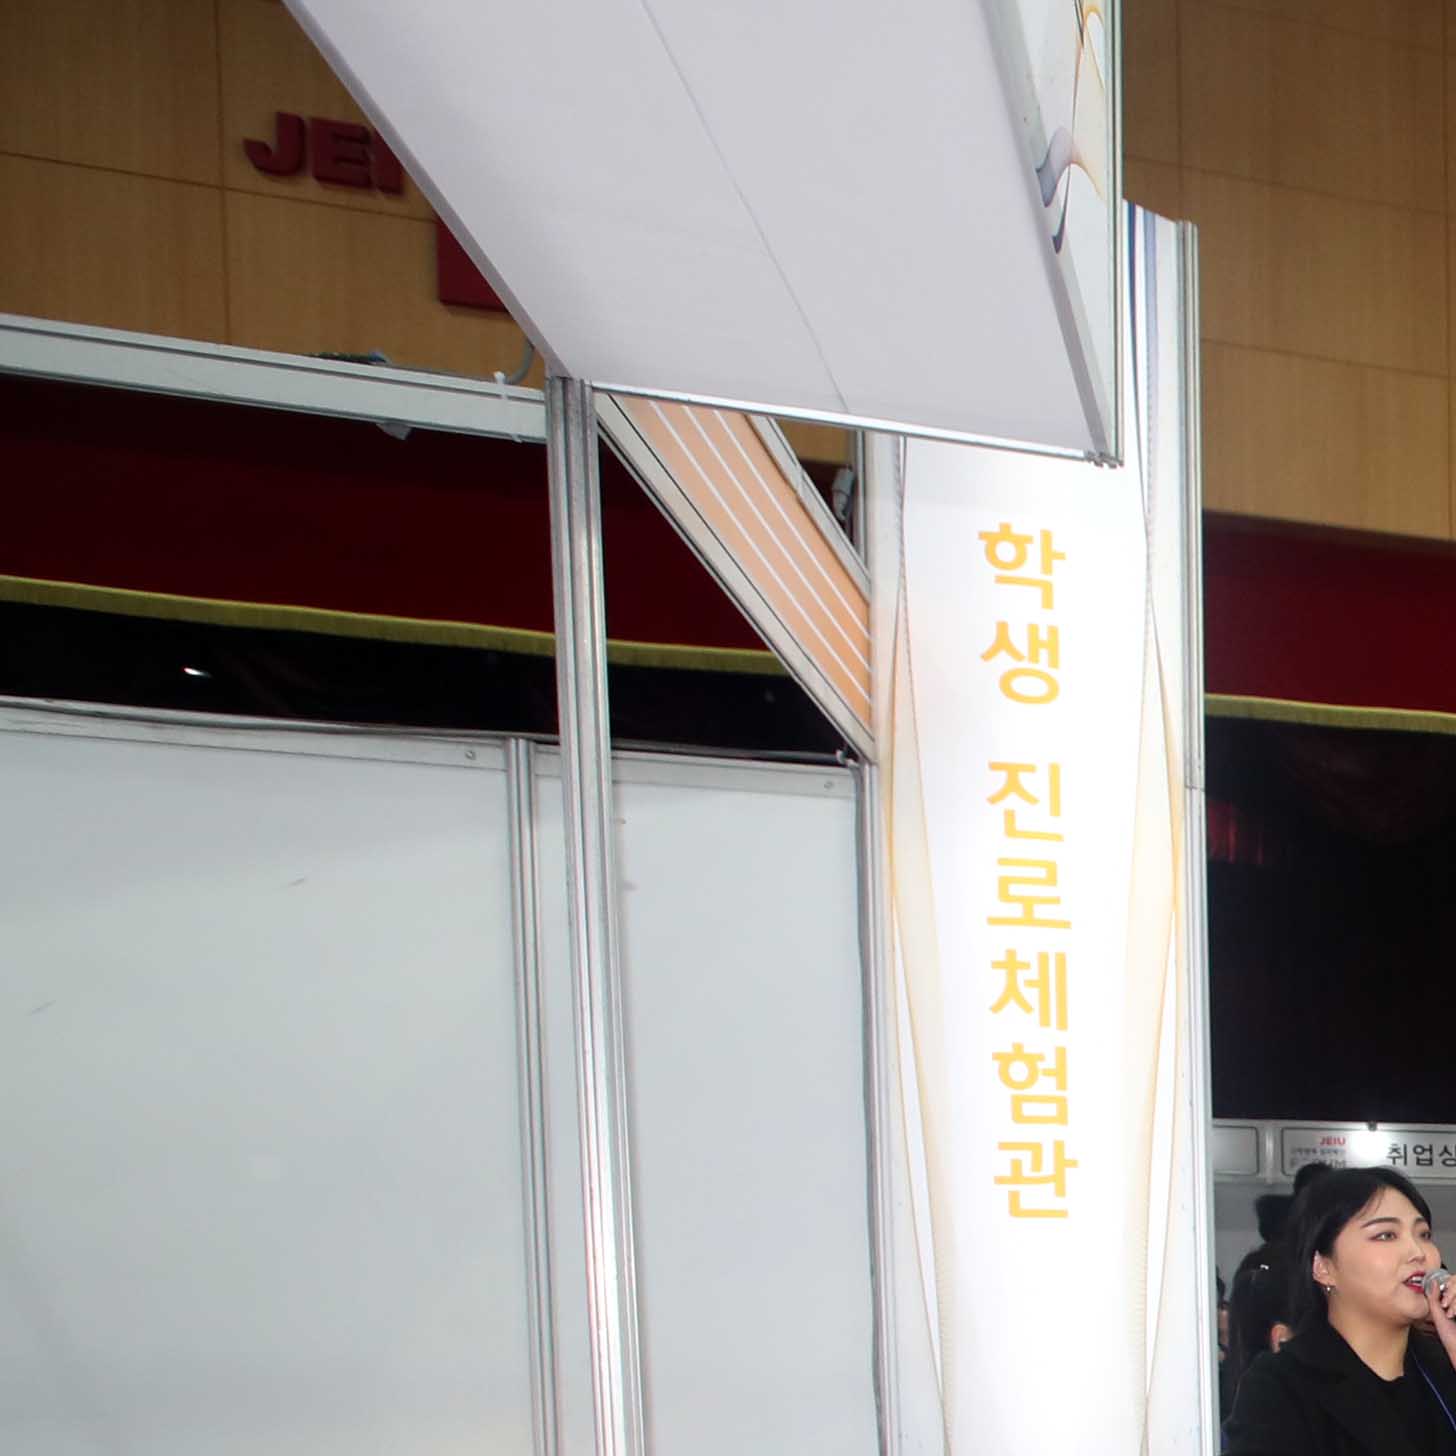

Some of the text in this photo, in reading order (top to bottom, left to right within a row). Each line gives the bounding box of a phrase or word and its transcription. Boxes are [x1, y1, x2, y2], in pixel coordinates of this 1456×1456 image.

[977, 522, 1078, 1220] 학생 진로체험관
[1319, 1136, 1346, 1146] JEIU
